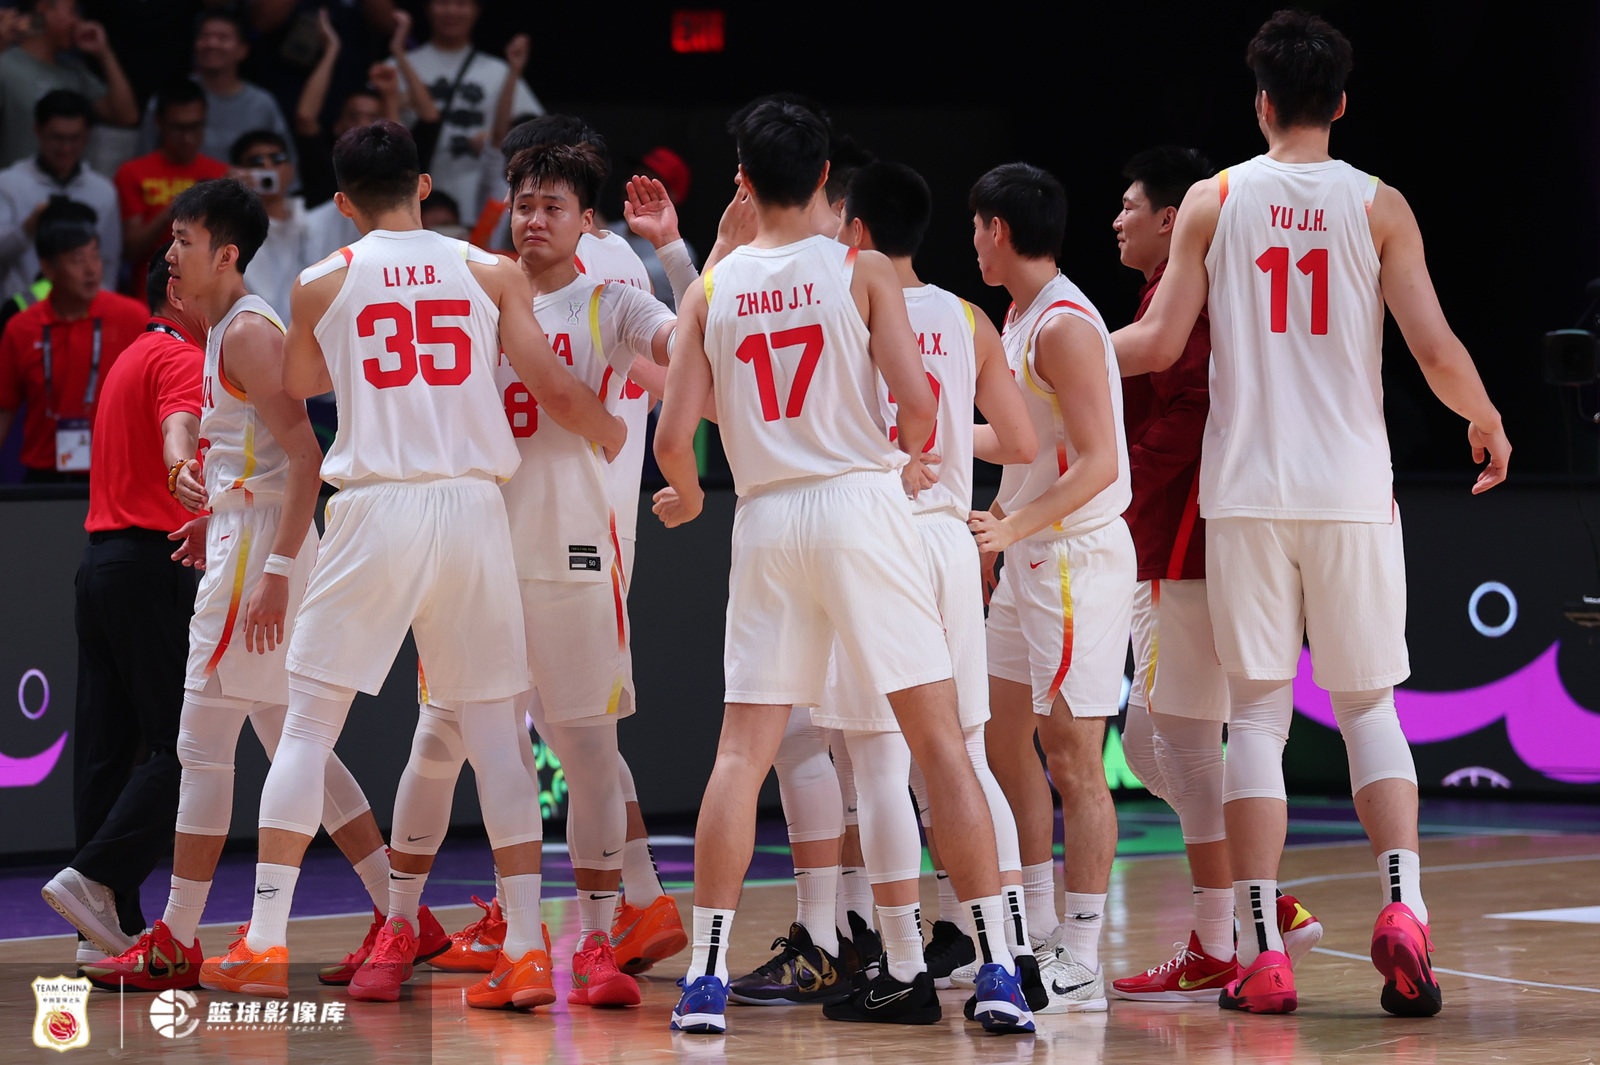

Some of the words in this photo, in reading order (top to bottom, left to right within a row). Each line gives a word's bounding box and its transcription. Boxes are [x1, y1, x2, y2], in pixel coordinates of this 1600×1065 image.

[1270, 204, 1293, 229] YU
[1297, 208, 1327, 231] J.H.
[383, 266, 401, 287] LI
[406, 265, 441, 286] X.B.
[735, 290, 784, 317] ZHAO
[788, 282, 821, 310] J.Y.
[1255, 246, 1328, 335] 11
[356, 299, 472, 390] 35
[735, 323, 825, 422] 17
[504, 382, 538, 438] 8
